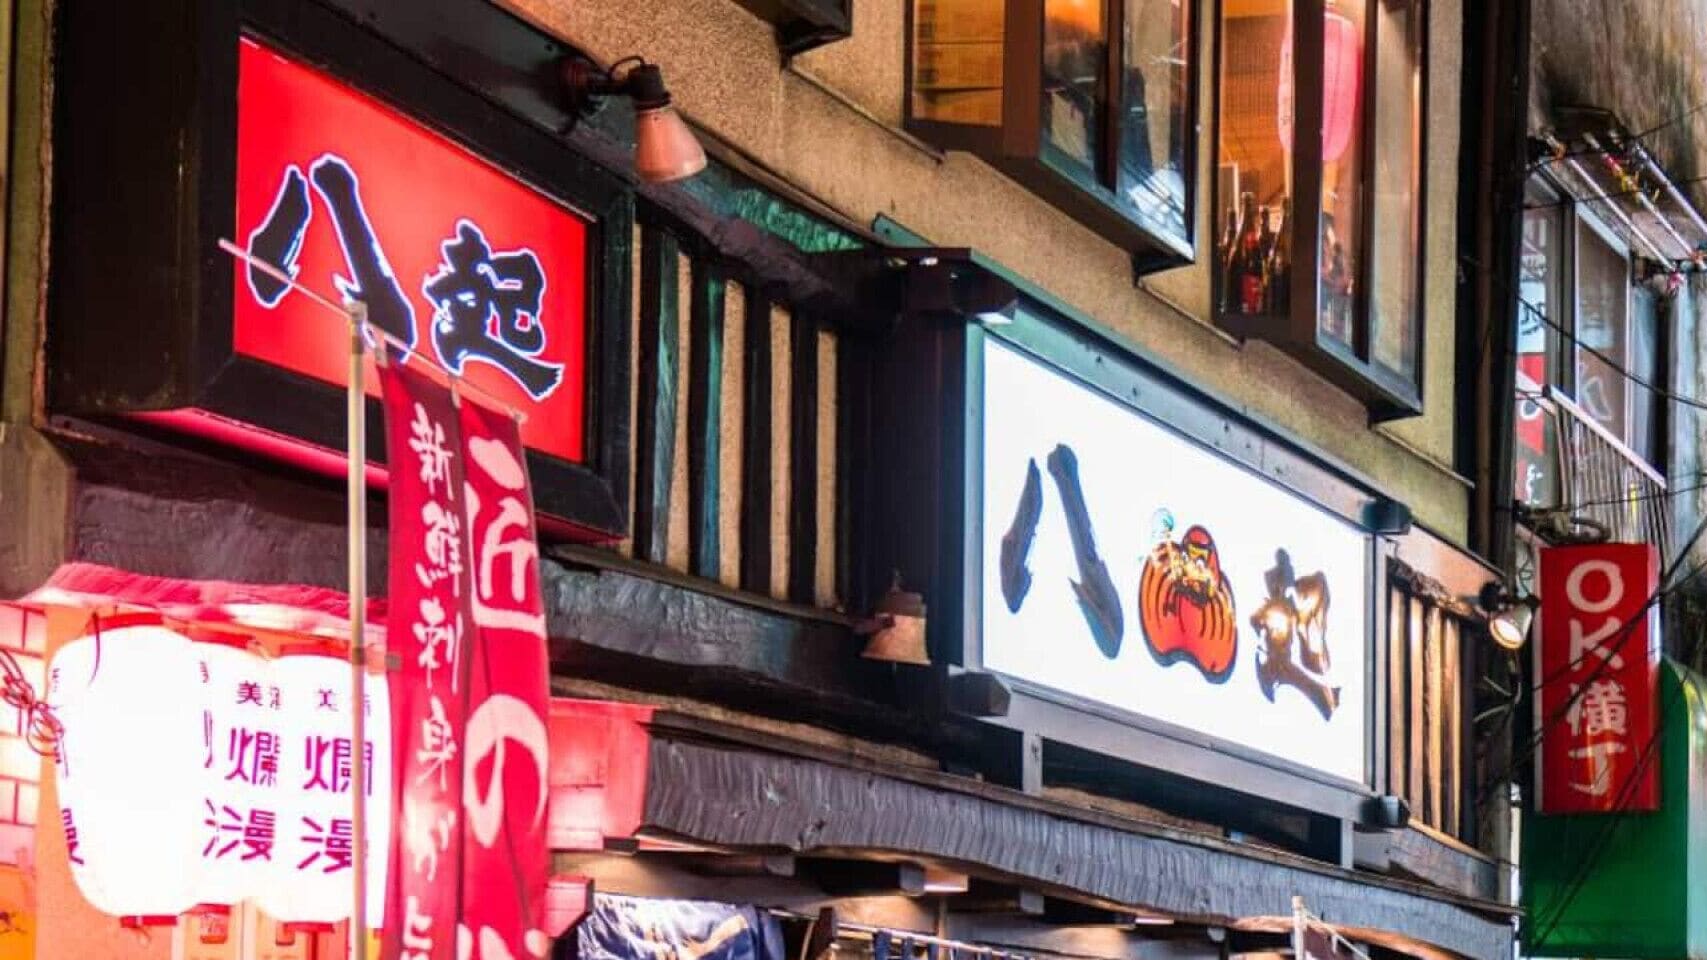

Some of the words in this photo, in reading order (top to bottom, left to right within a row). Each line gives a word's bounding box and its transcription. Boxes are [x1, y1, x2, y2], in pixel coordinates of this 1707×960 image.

[247, 153, 564, 400] 八起
[999, 443, 1341, 721] 八起
[1565, 559, 1628, 798] OK横丁
